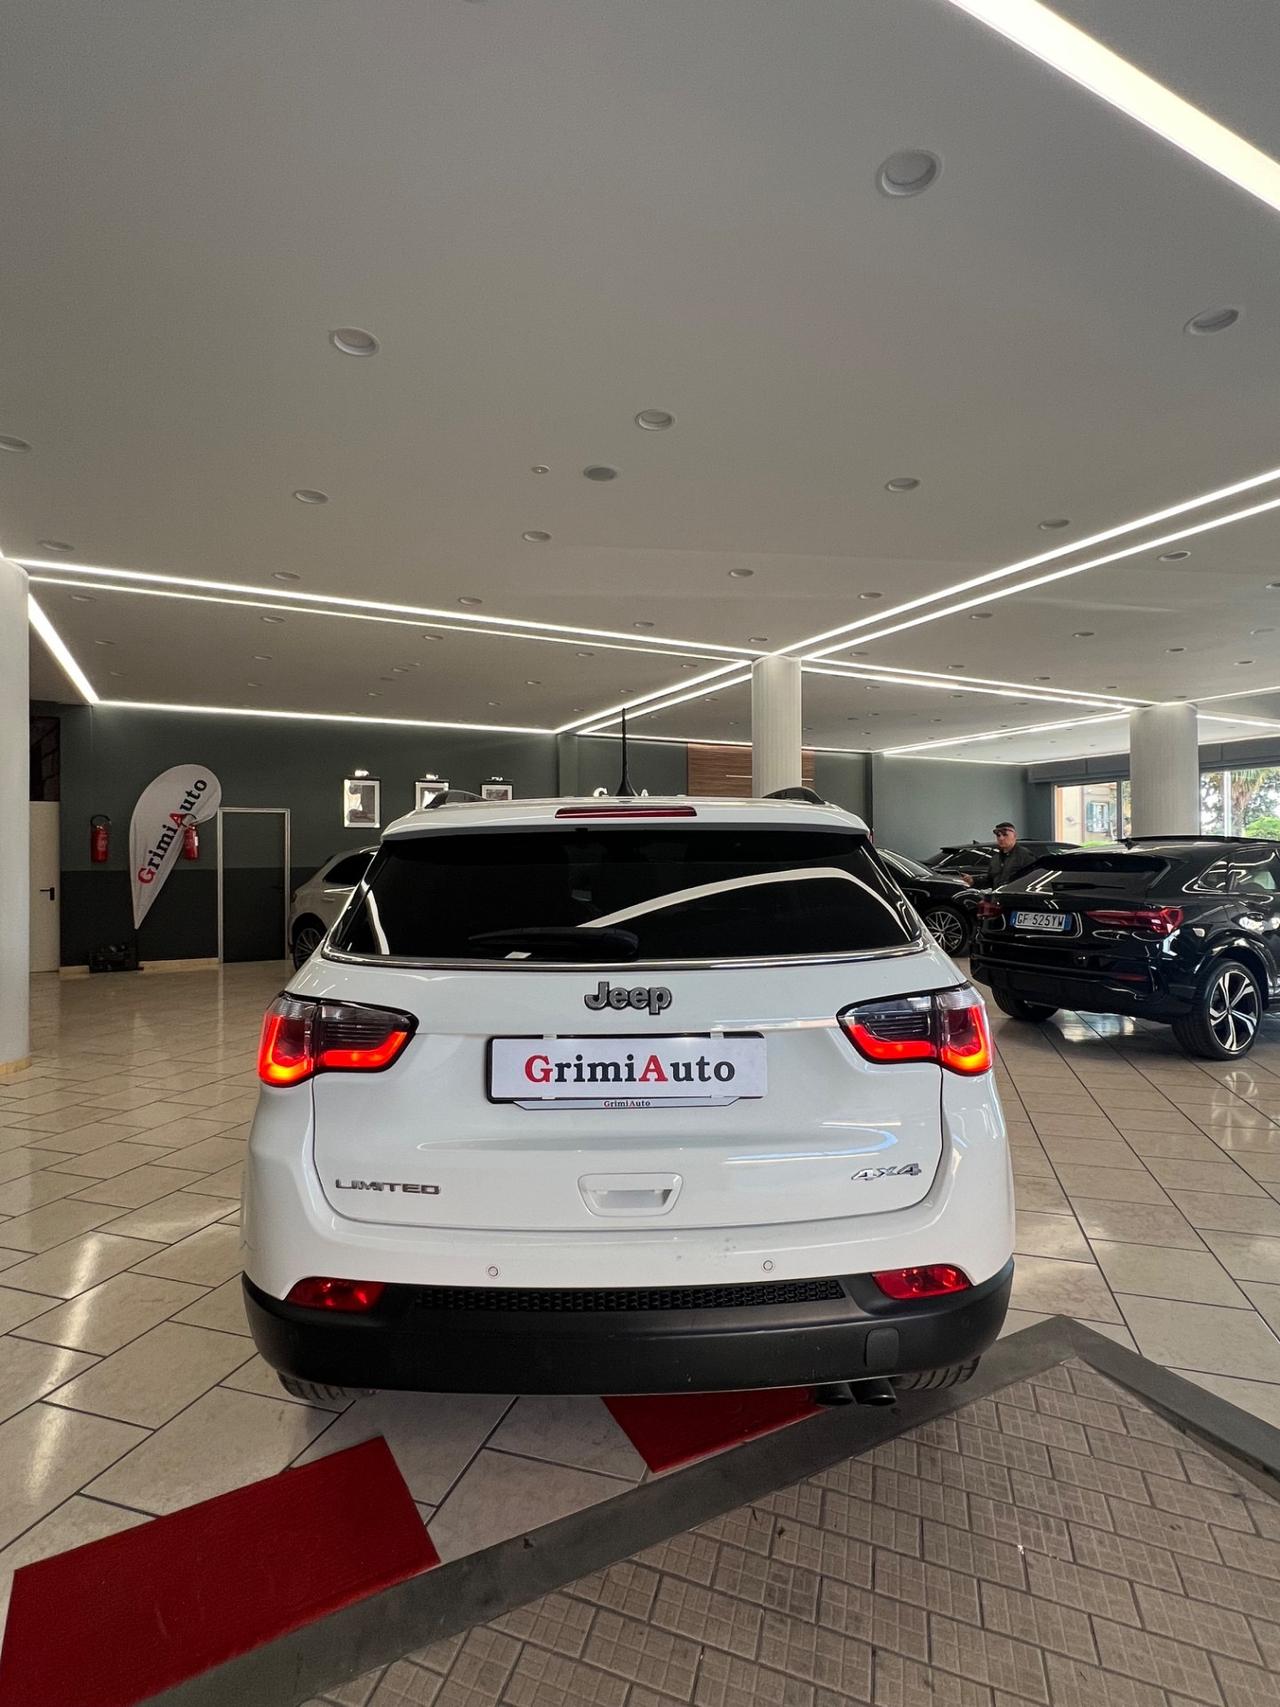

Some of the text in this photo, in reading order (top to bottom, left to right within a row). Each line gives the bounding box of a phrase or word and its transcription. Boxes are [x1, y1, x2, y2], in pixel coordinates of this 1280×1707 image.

[138, 779, 208, 884] GrimiAuto
[1017, 913, 1065, 927] GF 525YW
[584, 981, 672, 1015] Jeep
[524, 1053, 736, 1083] GrimiAuto
[335, 1179, 441, 1195] LIMITED
